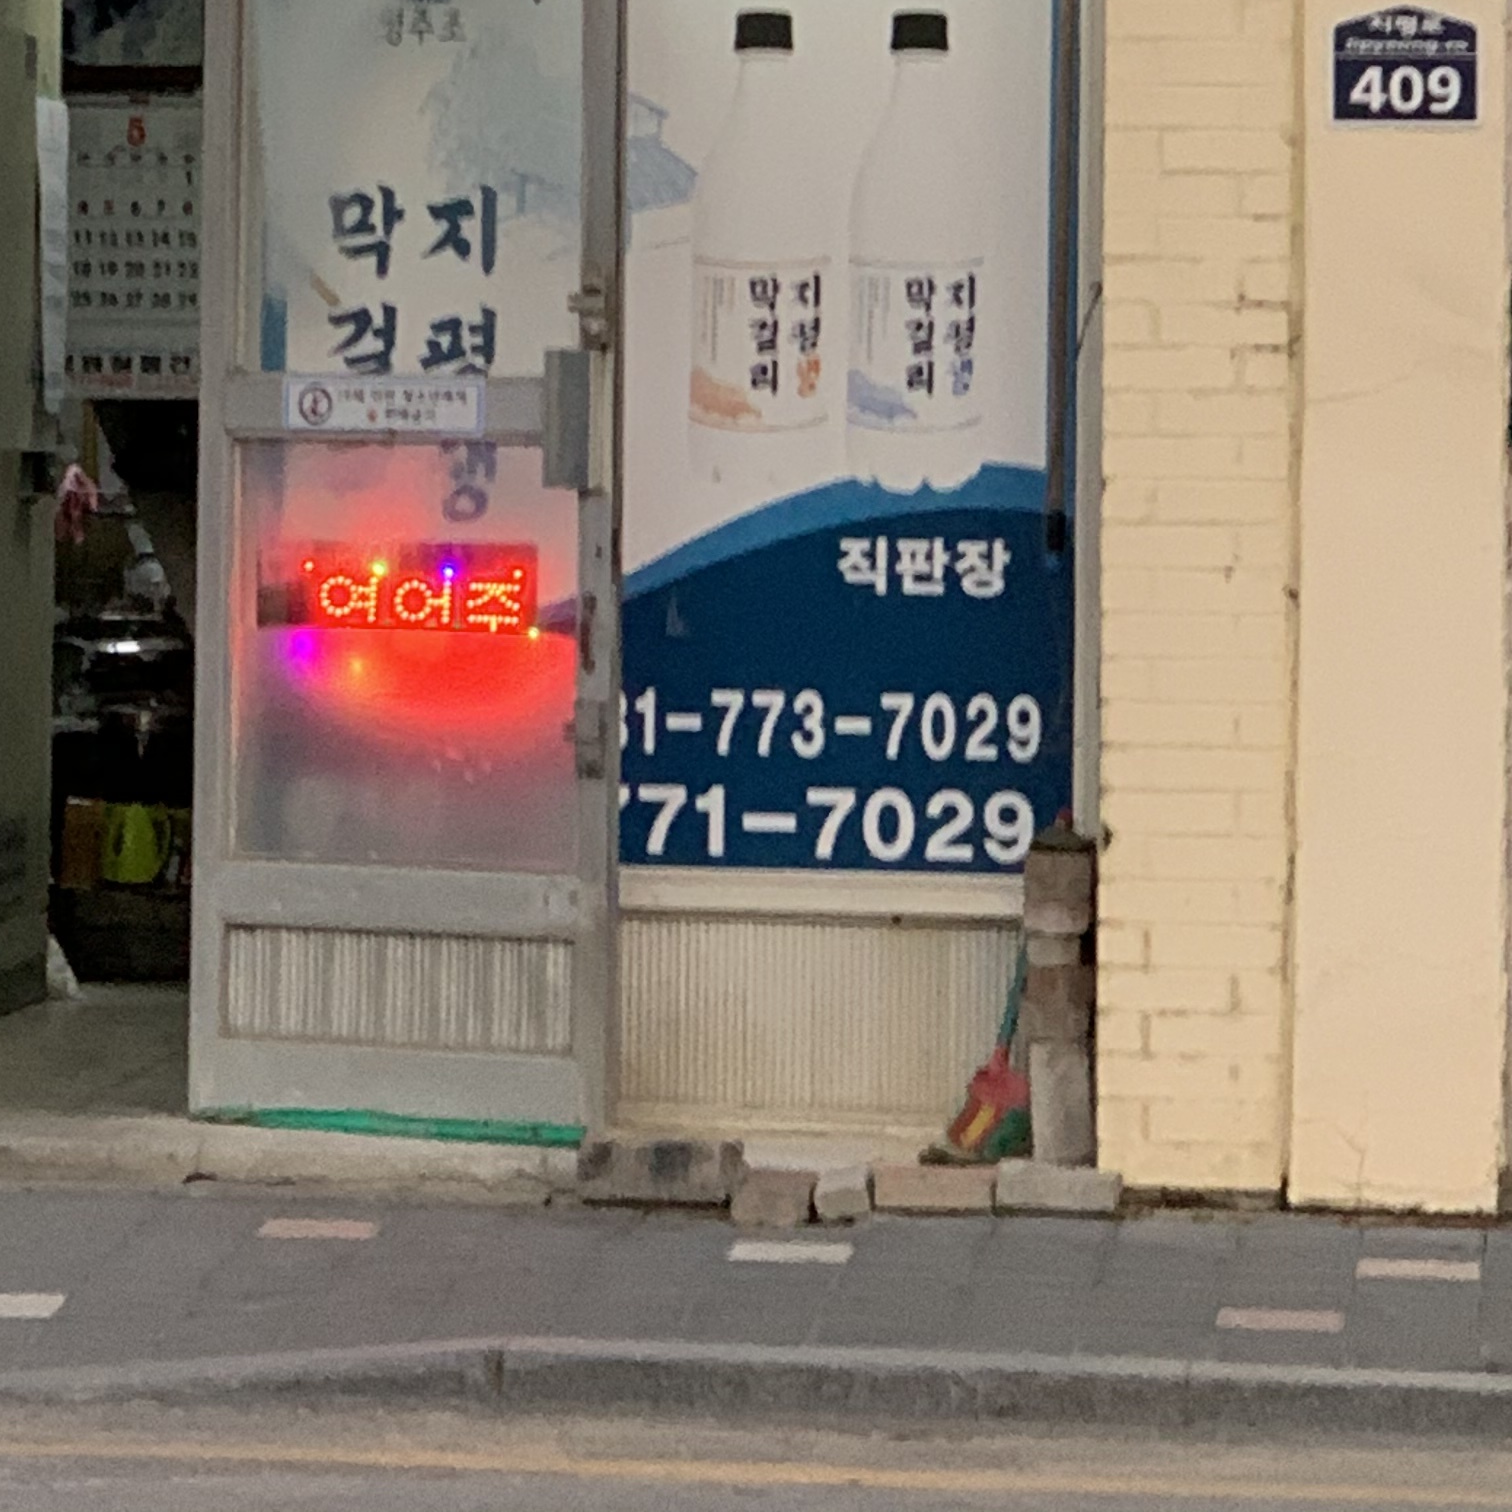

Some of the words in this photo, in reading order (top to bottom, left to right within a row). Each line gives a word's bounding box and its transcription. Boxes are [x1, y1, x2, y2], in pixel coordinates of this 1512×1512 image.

[1348, 64, 1462, 115] 409
[837, 535, 1011, 599] 직판장
[619, 686, 1042, 764] 1-773-7029
[619, 783, 1035, 866] 71-7029
